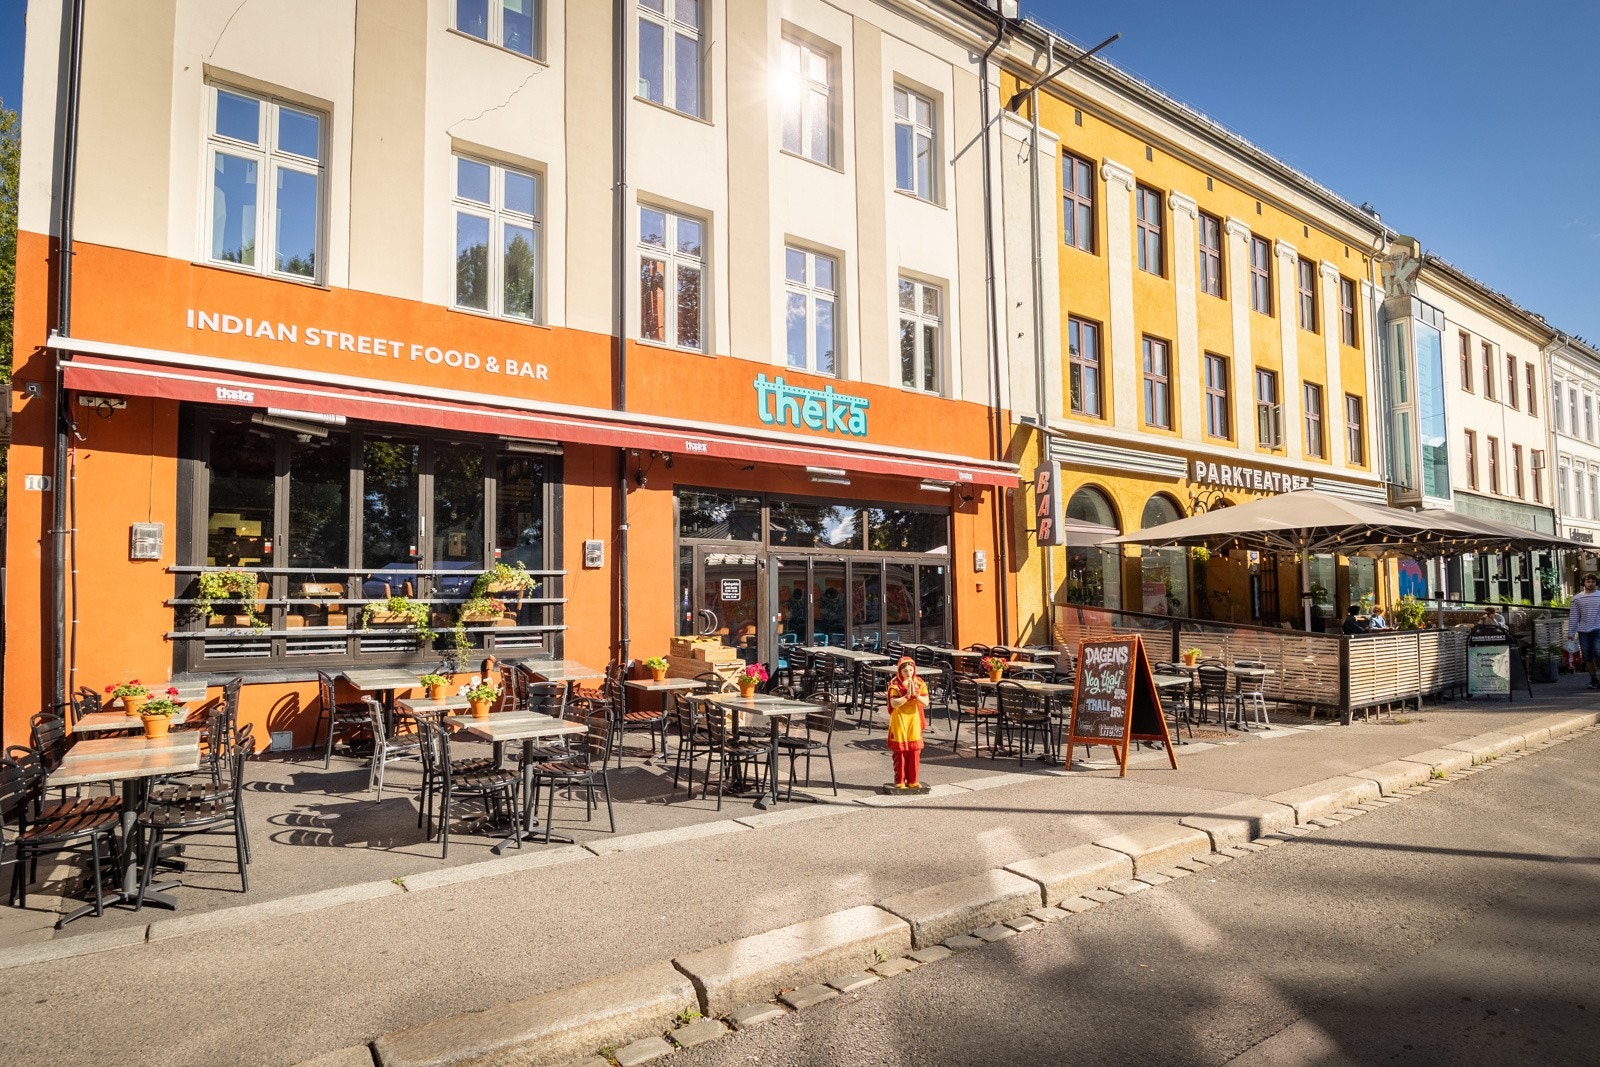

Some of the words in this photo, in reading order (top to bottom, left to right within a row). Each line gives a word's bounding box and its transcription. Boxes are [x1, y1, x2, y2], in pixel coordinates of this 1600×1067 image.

[186, 308, 297, 343] INDIAN
[305, 327, 404, 358] STREET
[410, 343, 481, 370] FOOD
[485, 355, 501, 373] &
[505, 359, 549, 381] BAR
[216, 387, 254, 402] theka
[753, 373, 869, 437] theka
[28, 477, 49, 490] 10
[1195, 461, 1309, 493] PARKTEATRET
[1037, 471, 1052, 540] BAR
[1085, 646, 1129, 665] DAGENS
[1085, 670, 1100, 694] Veg
[1086, 699, 1111, 712] THALI
